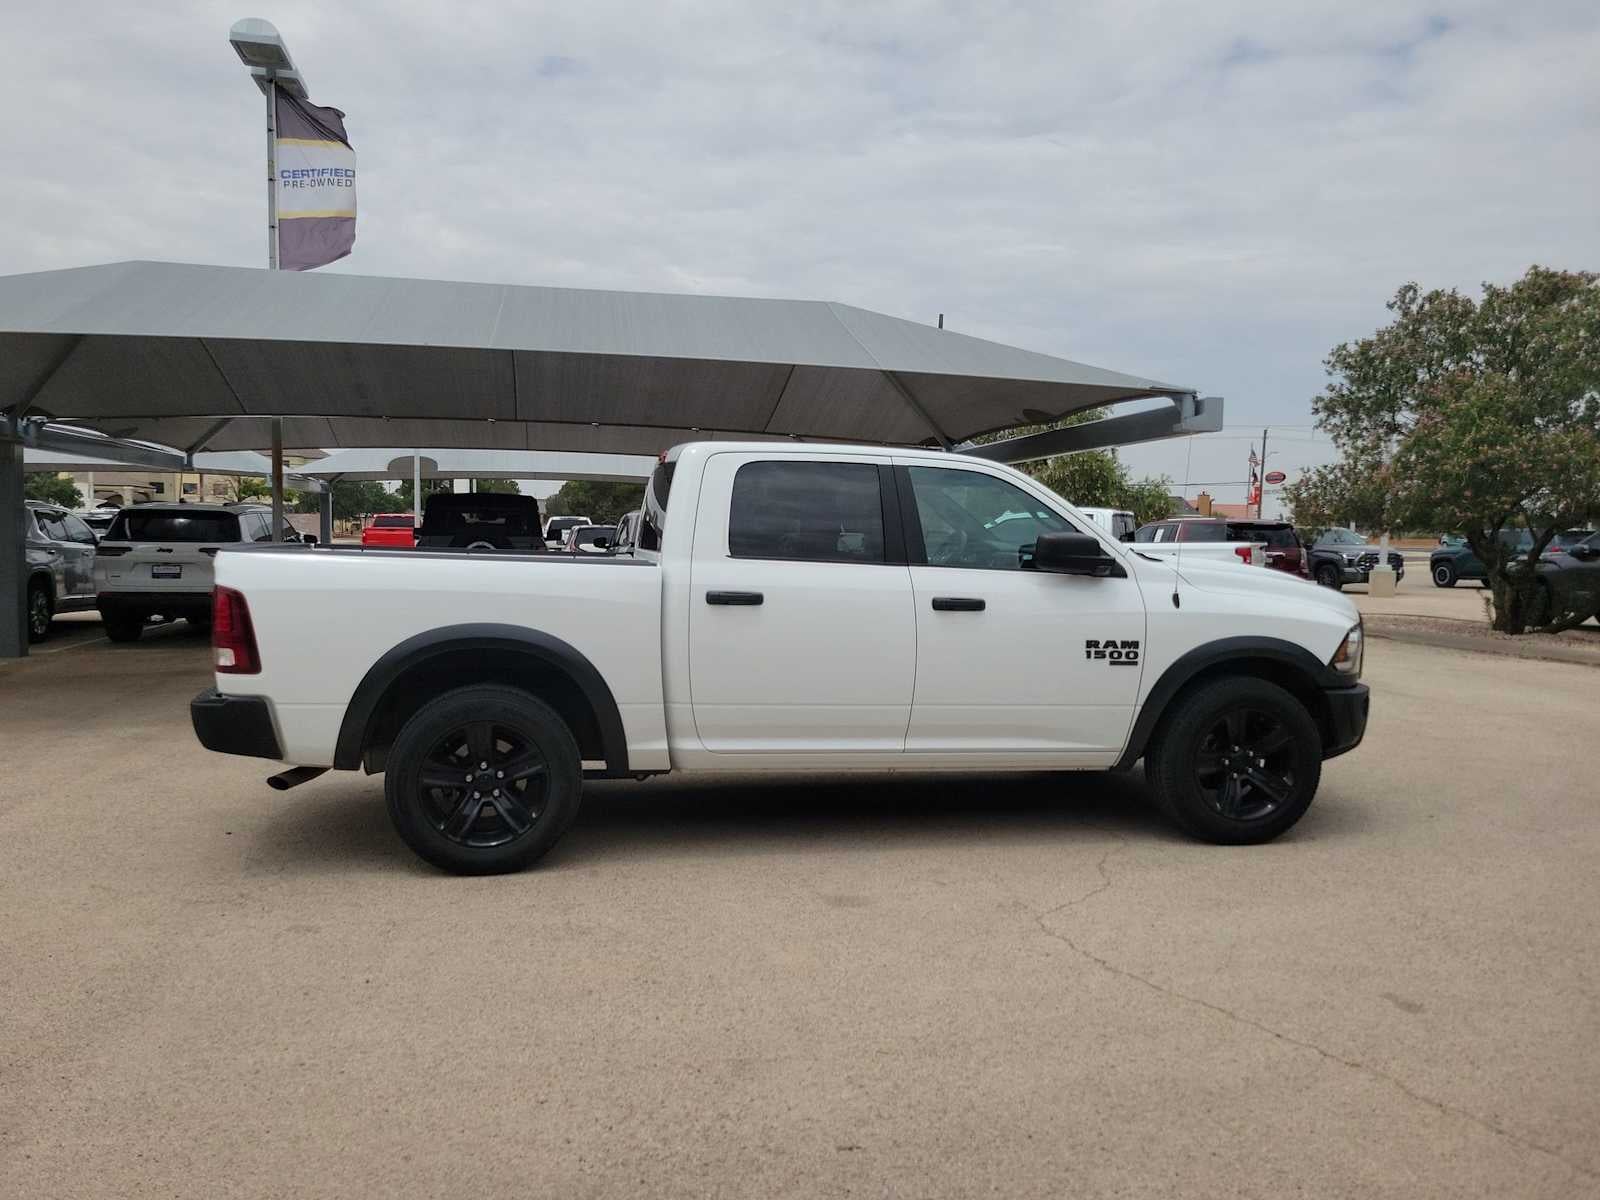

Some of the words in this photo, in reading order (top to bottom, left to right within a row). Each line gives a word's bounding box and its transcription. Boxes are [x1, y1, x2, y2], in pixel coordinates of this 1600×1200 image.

[280, 168, 356, 179] CERTIFIED
[283, 178, 353, 188] PRE-OWNED
[1086, 640, 1139, 650] RAM
[1086, 650, 1139, 660] 1500
